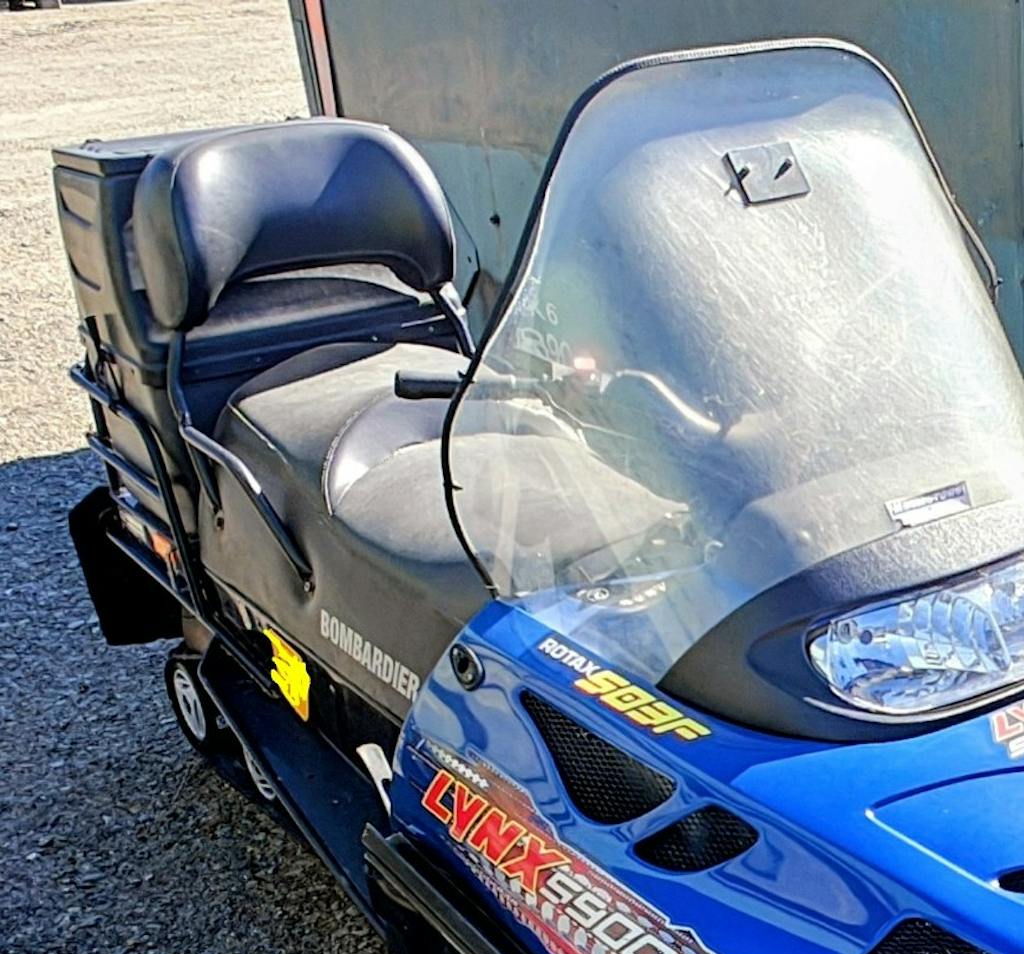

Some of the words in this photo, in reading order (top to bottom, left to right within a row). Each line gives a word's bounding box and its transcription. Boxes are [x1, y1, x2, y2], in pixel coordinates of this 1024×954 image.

[320, 609, 420, 702] BOMBARDIER
[538, 638, 597, 675] ROTAX
[421, 768, 569, 894] LYNX
